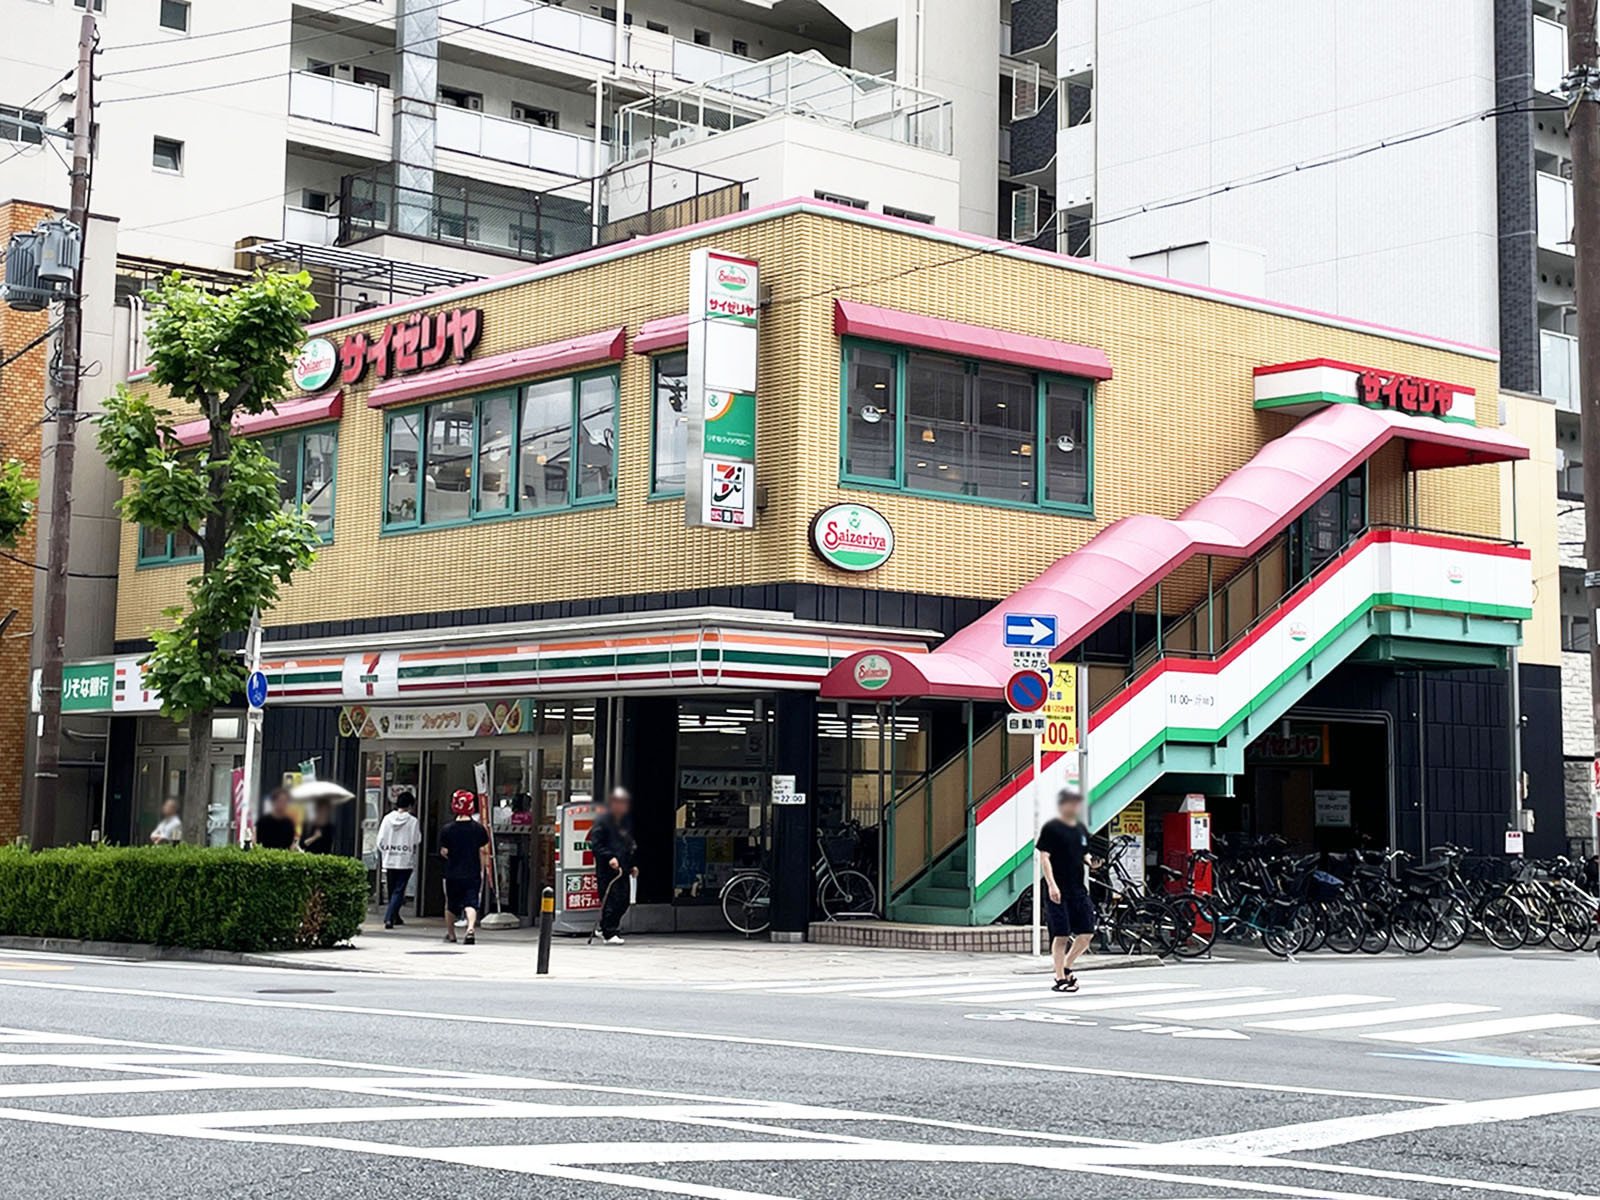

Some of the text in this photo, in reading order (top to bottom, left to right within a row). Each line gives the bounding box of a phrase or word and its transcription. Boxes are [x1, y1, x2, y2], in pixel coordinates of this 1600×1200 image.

[709, 298, 755, 317] サイゼリヤ
[340, 308, 482, 384] サイゼリヤ
[1361, 370, 1454, 416] サイゼリヤ
[823, 520, 887, 551] Saizeriya
[1013, 658, 1048, 668] ここから
[63, 675, 109, 700] りそな銀行
[1009, 718, 1045, 729] 自動車
[567, 875, 582, 891] 酒
[568, 893, 592, 907] 銀行
